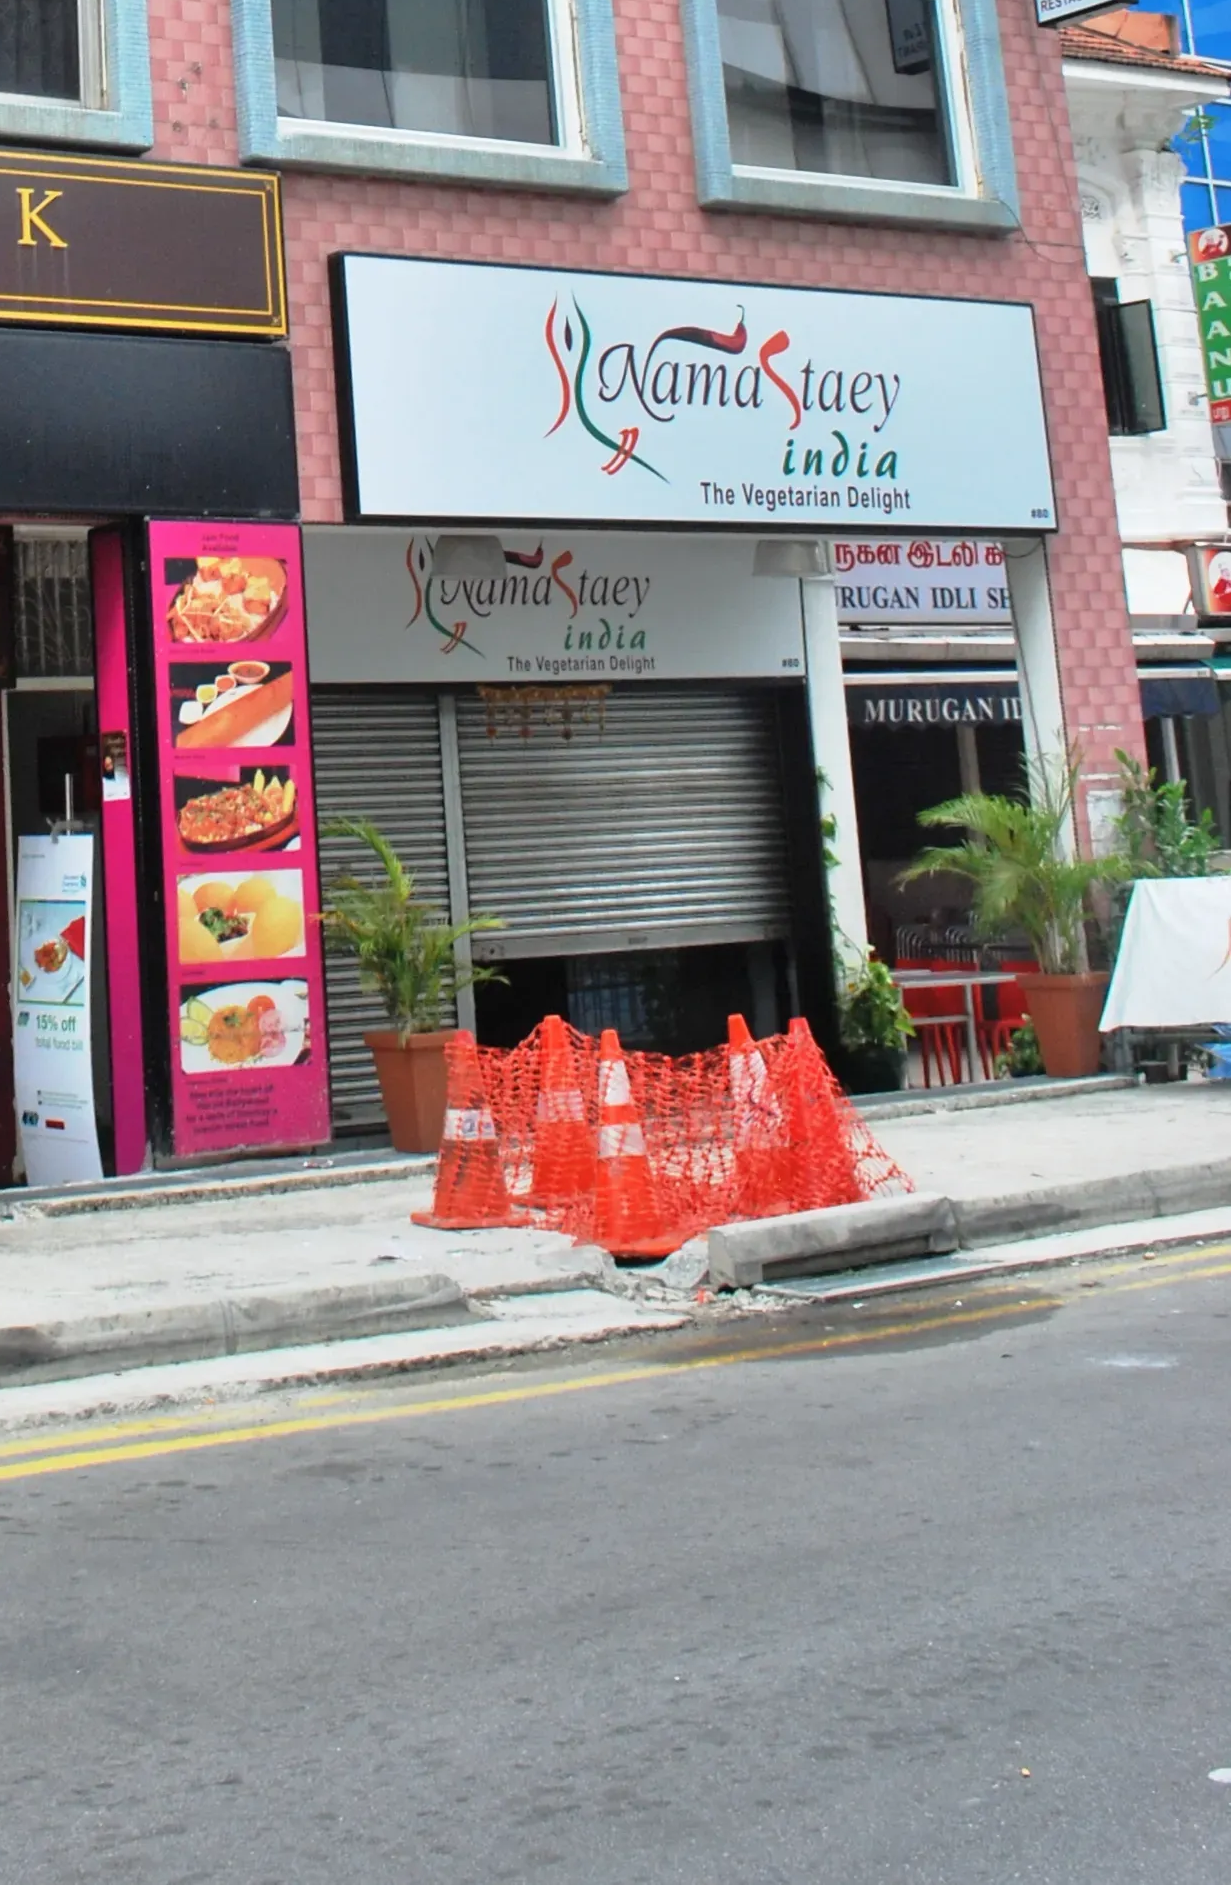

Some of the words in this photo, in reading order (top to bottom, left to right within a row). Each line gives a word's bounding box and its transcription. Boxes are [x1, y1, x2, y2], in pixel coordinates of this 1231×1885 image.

[782, 430, 898, 479] india
[700, 481, 735, 506] The
[741, 483, 841, 512] Vegetarian
[847, 486, 911, 513] Delight
[834, 586, 921, 609] RUGAN
[931, 586, 978, 609] IDLI
[563, 618, 647, 651] india
[507, 656, 531, 672] The
[535, 656, 605, 675] Vegetarian
[609, 656, 656, 675] Delight
[864, 697, 995, 723] MURUGAN
[35, 1014, 58, 1030] 15%
[61, 1015, 76, 1032] off
